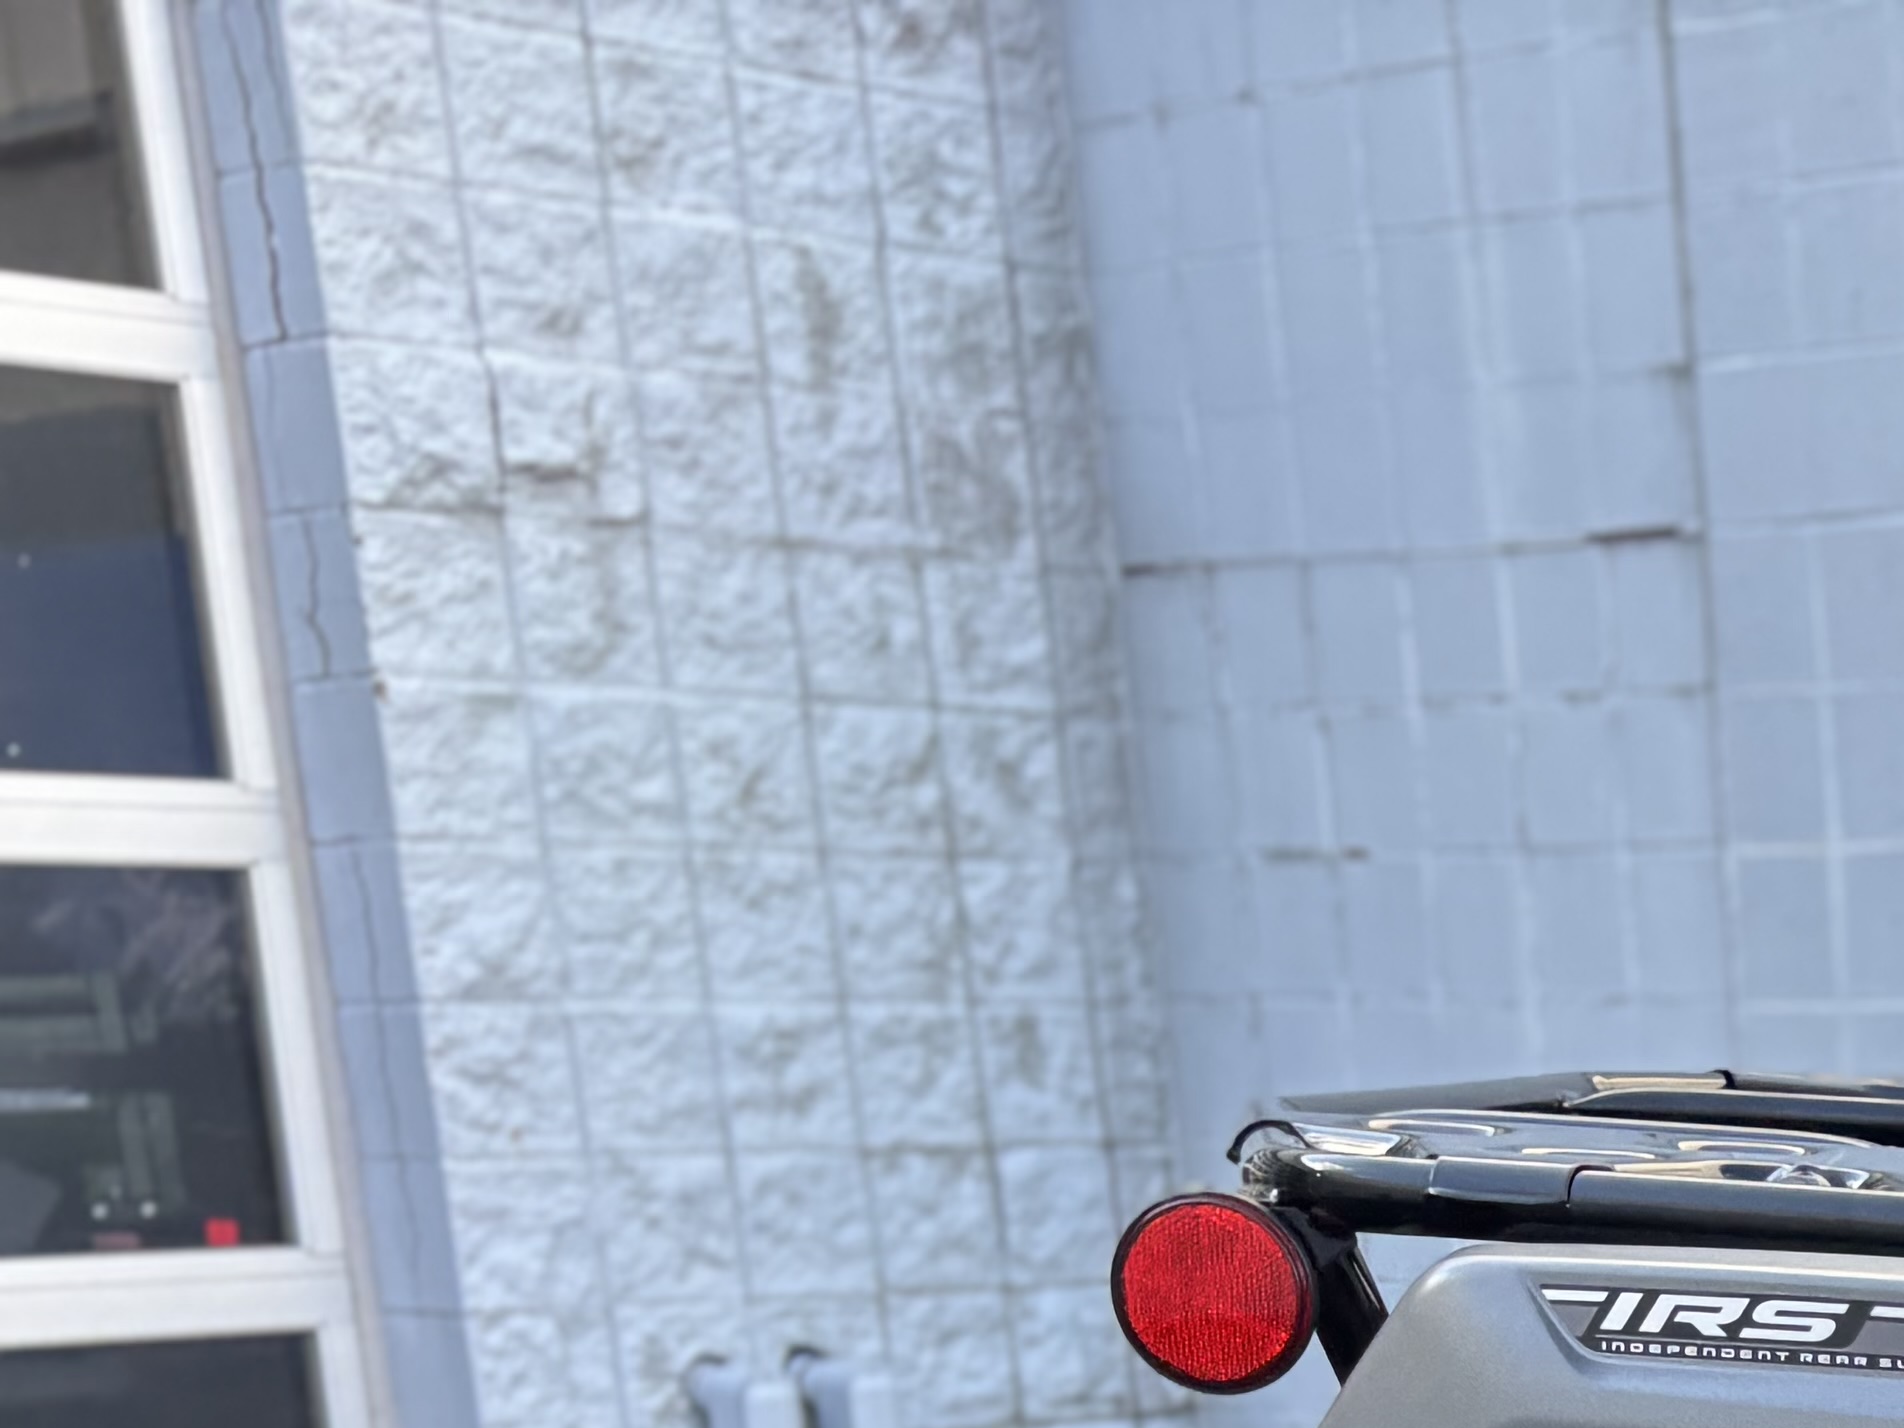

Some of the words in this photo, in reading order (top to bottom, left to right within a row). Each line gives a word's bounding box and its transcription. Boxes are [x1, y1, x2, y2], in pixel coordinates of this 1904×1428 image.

[1598, 1291, 1850, 1343] IRS
[1599, 1340, 1791, 1364] INDEPENDENT
[1799, 1351, 1869, 1369] REAR
